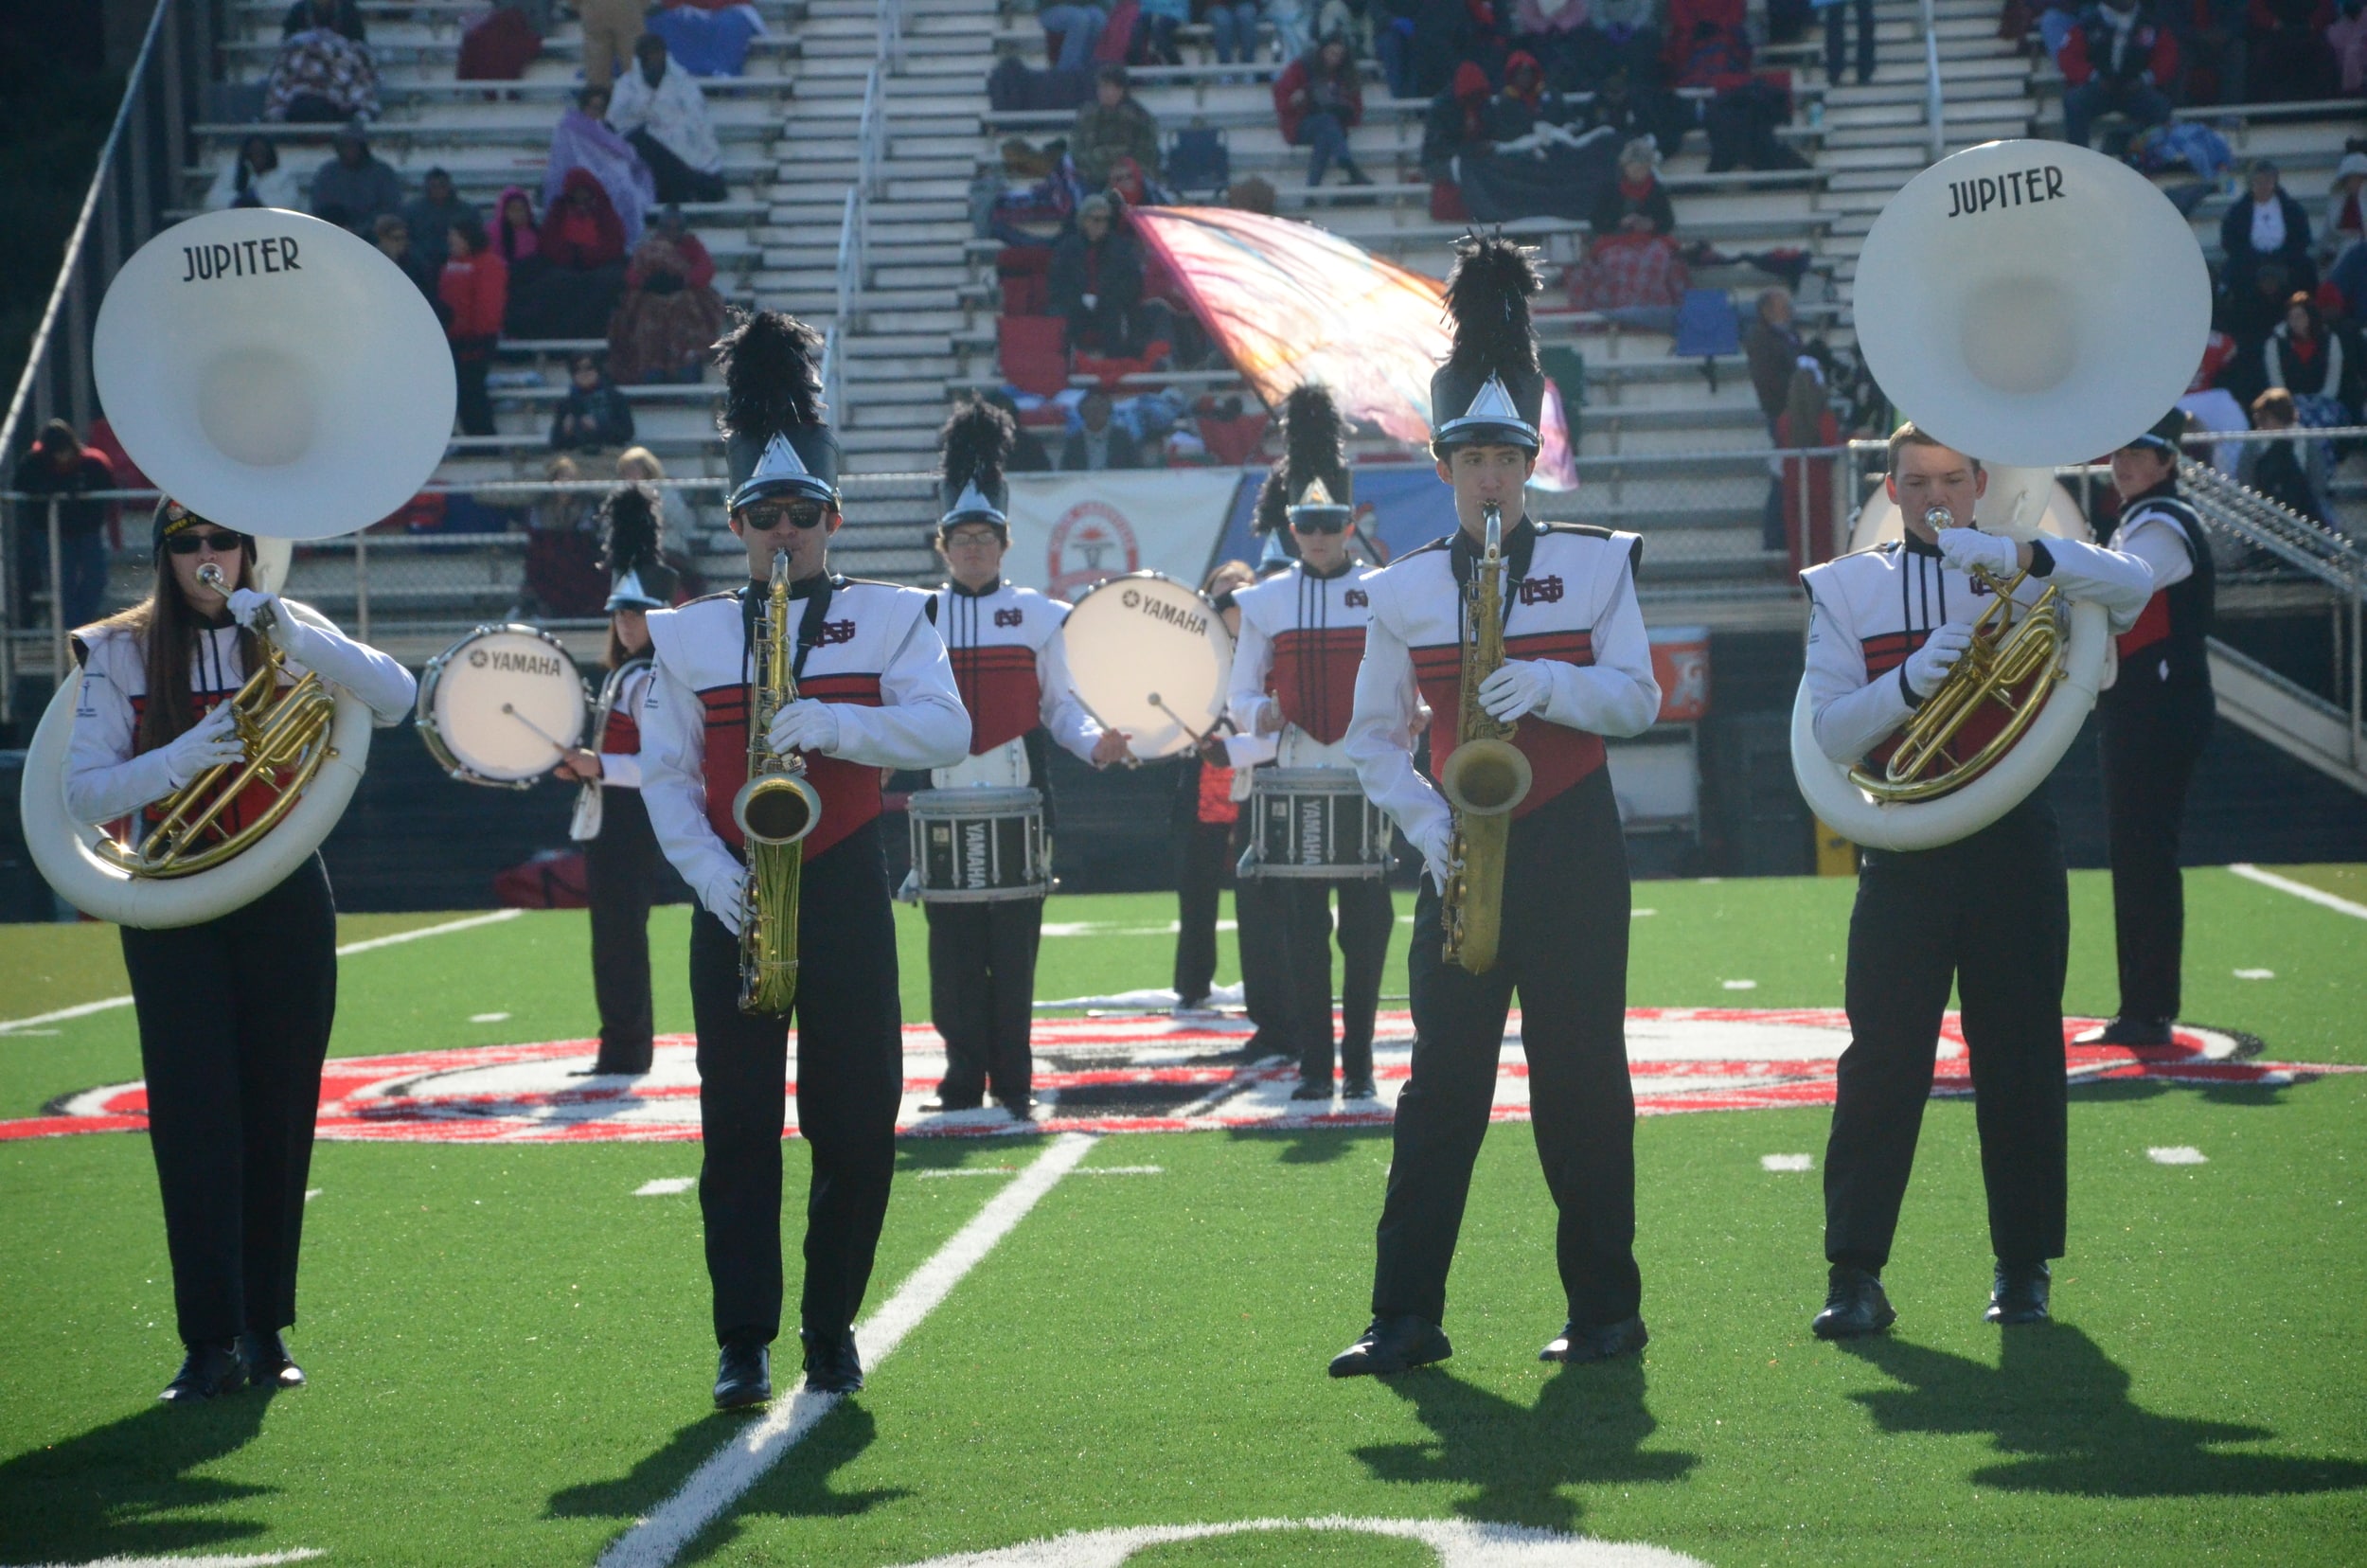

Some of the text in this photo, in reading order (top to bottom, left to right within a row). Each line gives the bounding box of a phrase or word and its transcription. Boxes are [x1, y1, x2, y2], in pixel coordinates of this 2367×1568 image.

[1949, 166, 2066, 218] JUPITER
[184, 237, 301, 282] JUPITER
[1142, 596, 1207, 637] YAMAHA
[491, 650, 561, 677] YAMAHA
[966, 822, 986, 889] YAMAHA
[1303, 801, 1321, 865] YAMAHA
